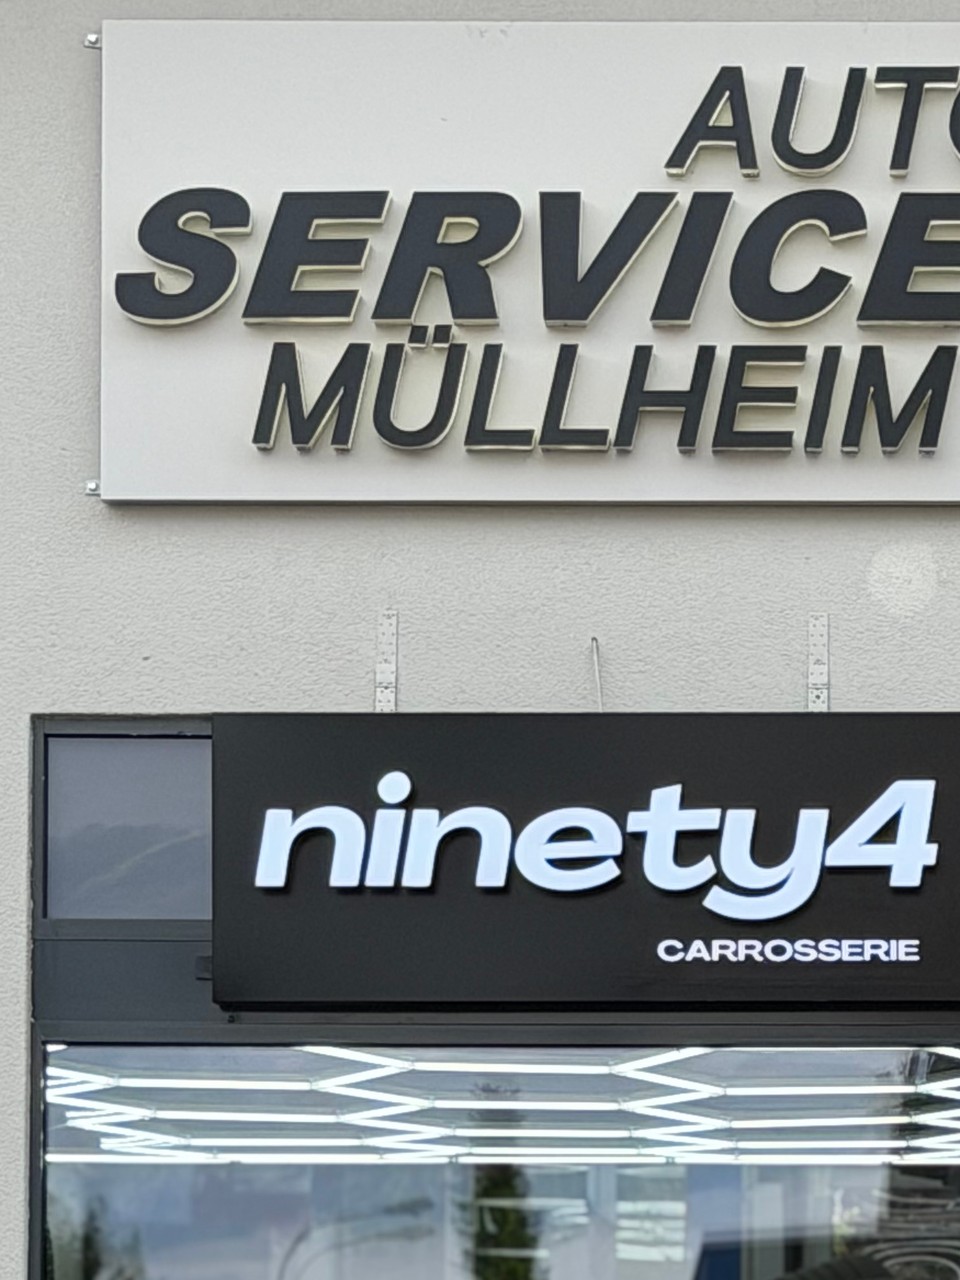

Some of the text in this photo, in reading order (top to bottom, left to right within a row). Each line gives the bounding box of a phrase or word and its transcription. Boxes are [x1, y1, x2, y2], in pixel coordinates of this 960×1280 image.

[252, 324, 959, 453] MÜLLHEIM
[255, 771, 939, 920] ninety4
[656, 938, 921, 963] CARROSSERIE
